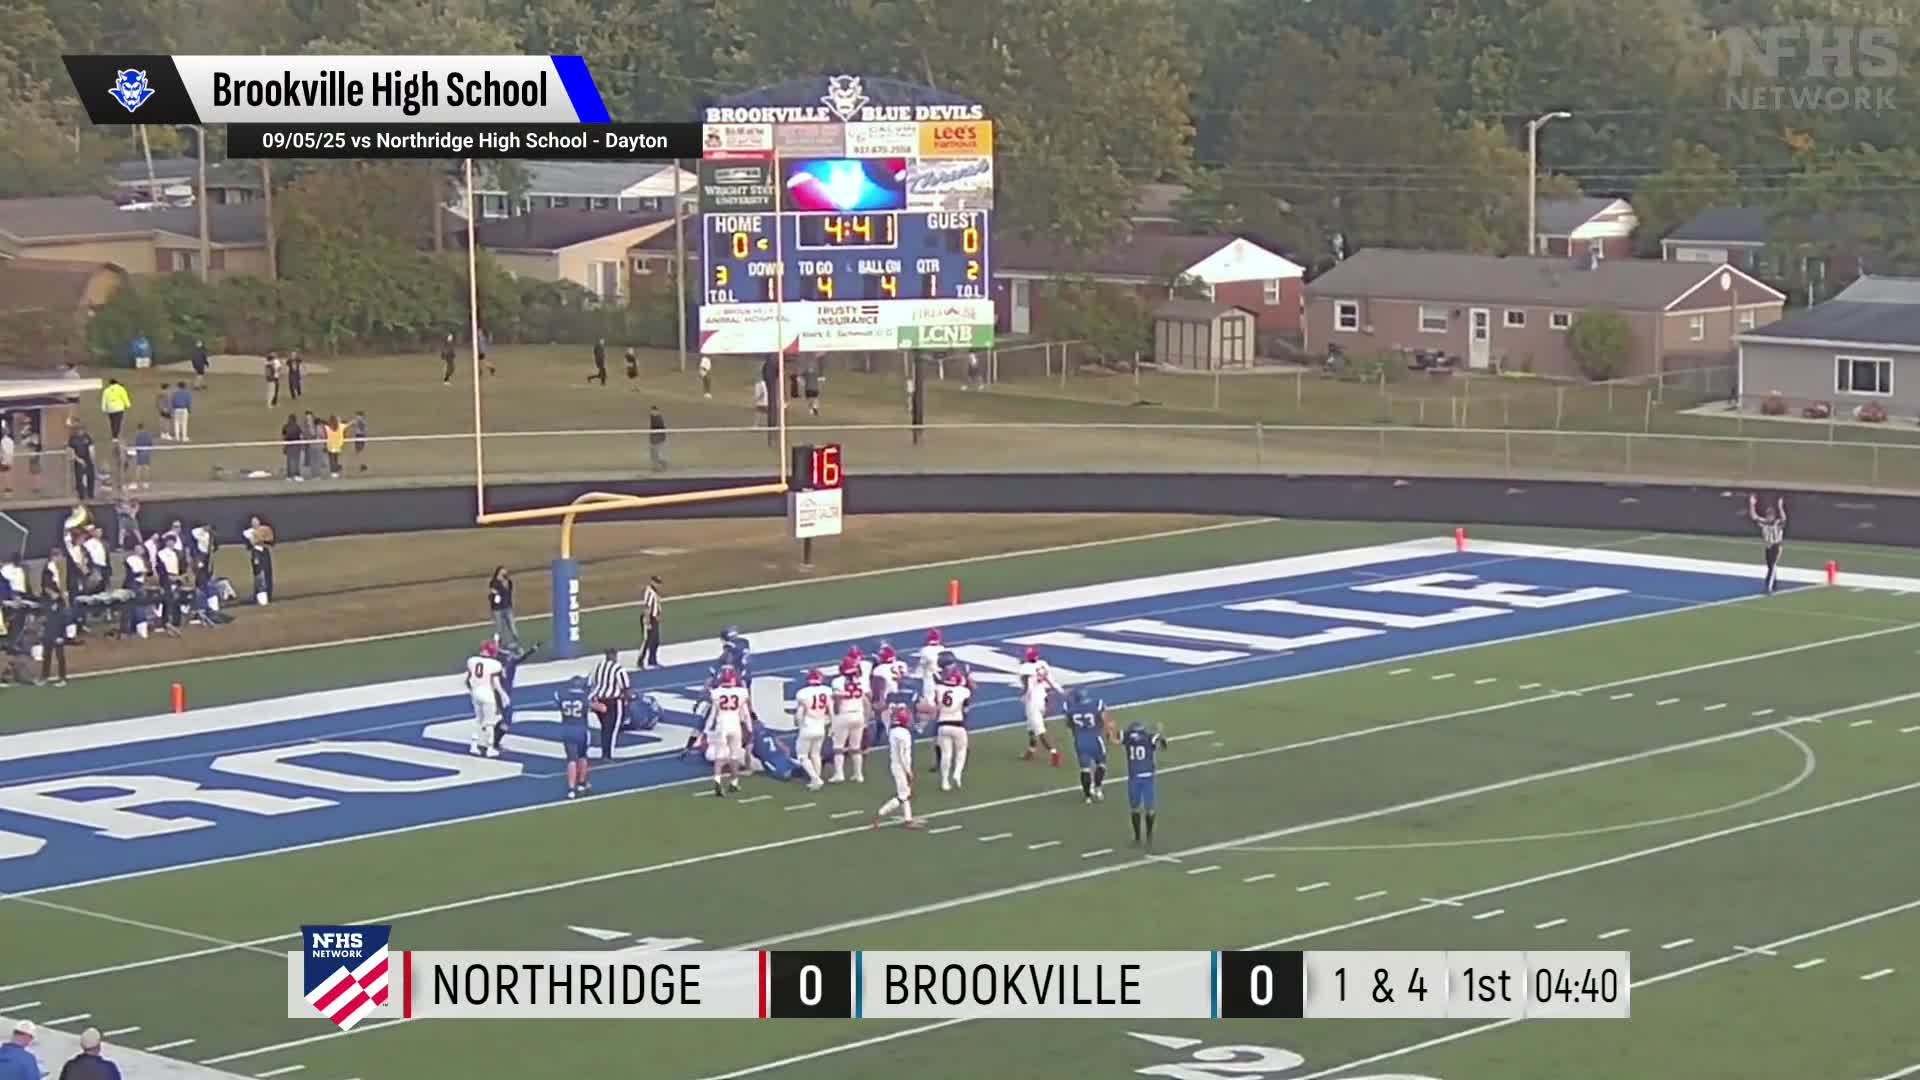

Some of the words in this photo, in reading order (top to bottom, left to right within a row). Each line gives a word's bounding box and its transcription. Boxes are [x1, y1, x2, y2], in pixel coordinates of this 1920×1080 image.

[706, 106, 830, 122] BROOKVILLE
[862, 105, 911, 121] BLUE
[916, 105, 983, 121] DEVILS
[933, 125, 977, 140] Lee's
[704, 185, 748, 196] WRIGHT
[716, 196, 769, 206] UNIVERSITY
[715, 216, 762, 233] HOME
[927, 212, 979, 229] GUEST
[824, 216, 894, 243] 4:41
[732, 232, 749, 258] 0
[963, 228, 979, 254] 0
[748, 262, 784, 276] DOWN
[798, 261, 815, 275] TO
[816, 261, 833, 275] GO
[858, 260, 886, 274] BALL
[887, 259, 901, 274] ON
[916, 258, 940, 273] QTR
[967, 260, 980, 280] 2
[715, 265, 728, 286] 3
[768, 277, 776, 301] 1
[817, 276, 832, 299] 4
[881, 275, 897, 297] 4
[929, 274, 937, 297] 1
[817, 305, 858, 315] TRUSTY
[817, 315, 879, 325] INSURANCE
[918, 324, 974, 342] LCNB
[812, 446, 839, 486] 16
[474, 661, 484, 678] 0
[561, 699, 583, 718] 52
[719, 694, 740, 711] 23
[812, 693, 828, 710] 19
[1072, 712, 1096, 728] 53
[1129, 745, 1146, 761] 10
